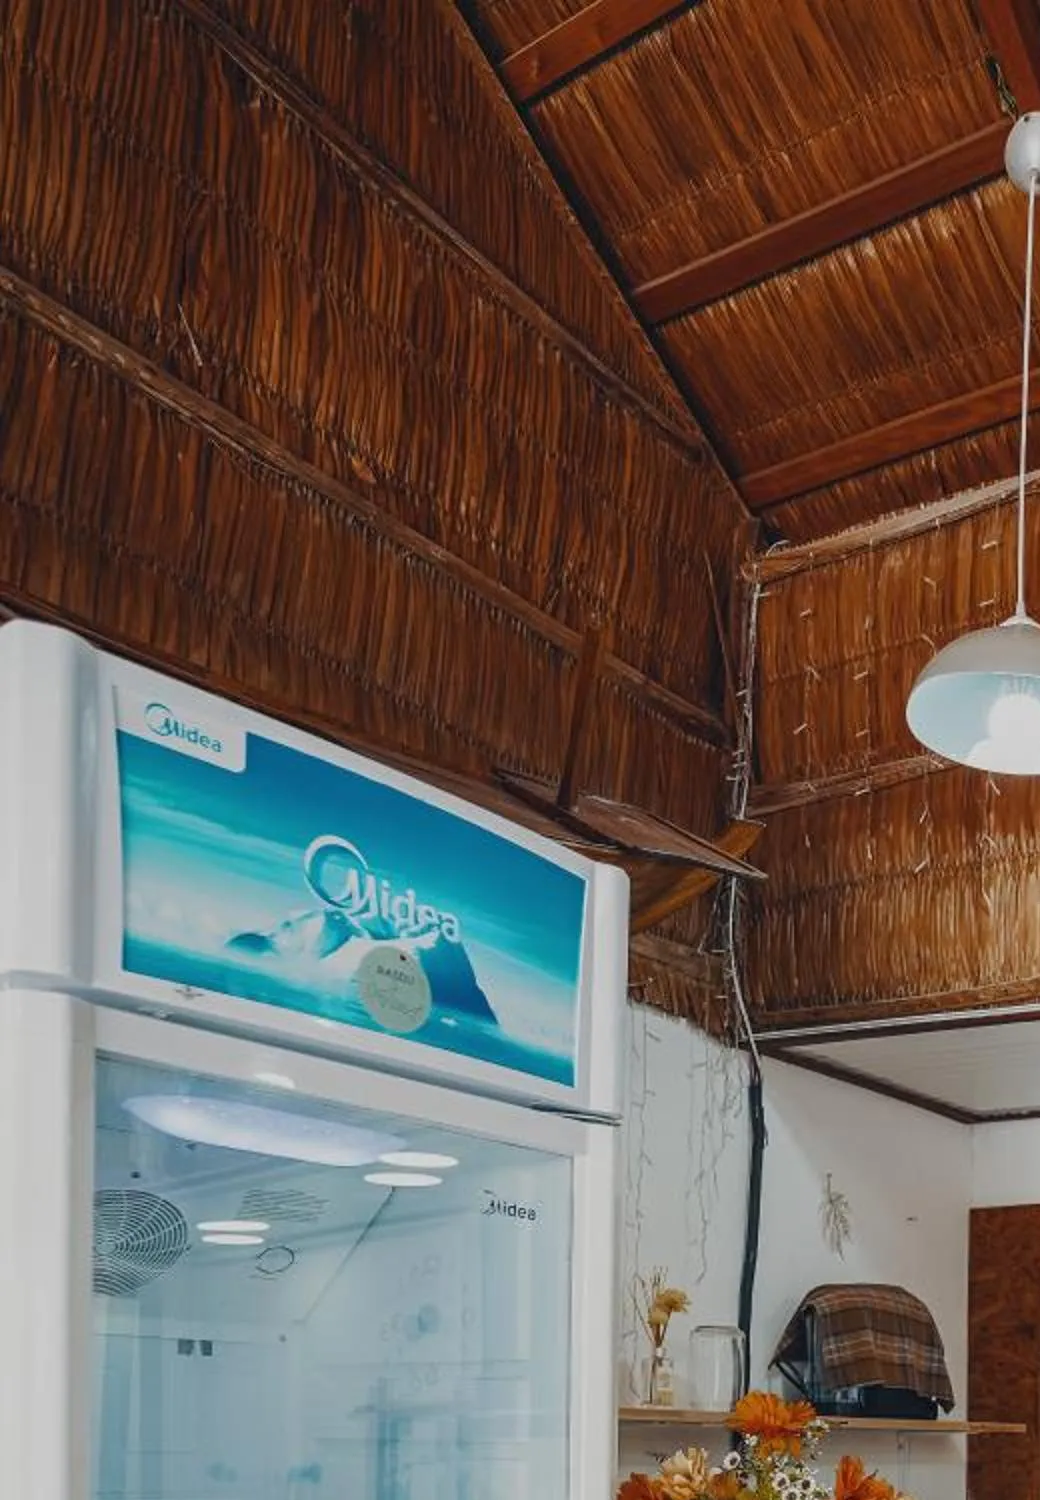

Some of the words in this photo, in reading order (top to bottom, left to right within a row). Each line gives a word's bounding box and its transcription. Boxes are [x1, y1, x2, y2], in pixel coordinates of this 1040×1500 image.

[143, 703, 223, 753] Midea
[303, 834, 461, 944] Midea
[480, 1189, 537, 1221] Midea
